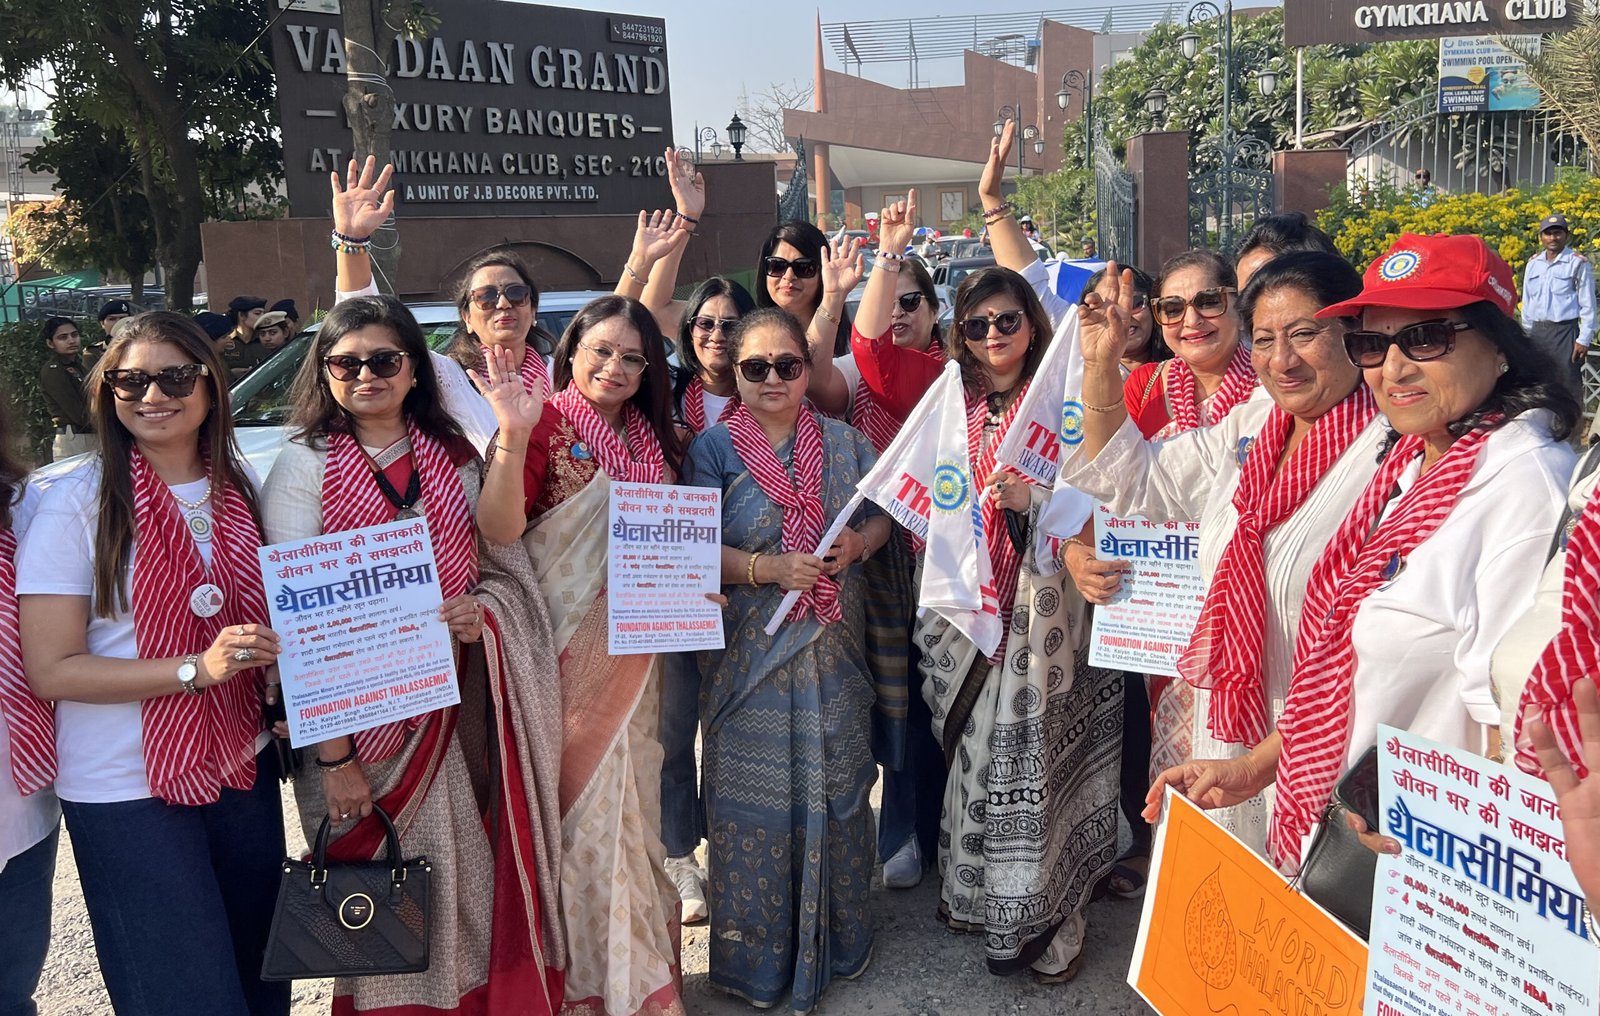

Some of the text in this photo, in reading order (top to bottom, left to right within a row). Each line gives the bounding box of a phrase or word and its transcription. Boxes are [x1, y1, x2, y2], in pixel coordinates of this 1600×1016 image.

[1354, 0, 1567, 28] GYMKHANA CLUB
[287, 25, 666, 94] VADAAN GRAND
[1442, 58, 1477, 67] SWIMMING
[1478, 56, 1494, 65] POOL
[1496, 56, 1512, 64] OPEN
[1442, 95, 1485, 104] SWIMMING
[347, 102, 636, 139] XURY BANQUETS
[311, 148, 342, 172] AT
[388, 149, 495, 174] MKHANA
[502, 152, 567, 180] CLUB,
[574, 154, 613, 176] SEC
[406, 186, 415, 200] A
[418, 186, 449, 200] UNIT
[454, 186, 469, 200] OF
[496, 186, 544, 200] DECORE
[547, 186, 572, 200] PVT.
[574, 186, 599, 200] LTD.
[1026, 420, 1060, 464] Th
[618, 501, 715, 516] जीवन भर की समझदारी
[668, 490, 678, 500] की
[683, 492, 718, 503] जानकारी
[613, 517, 716, 543] थैलासीमिया
[1105, 517, 1135, 528] जीवन
[269, 523, 424, 562] थैलासीमिया की जानकारी
[276, 540, 423, 578] जीवन भर की समझदारी
[277, 564, 431, 612] थैलासीमिया
[616, 620, 716, 632] FOUNDATION AGAINST THALASSAEMIA
[1100, 636, 1141, 649] FOUNDATION
[1143, 641, 1172, 653] AGAINST
[300, 698, 351, 719] FOUNDATION
[354, 688, 387, 706] AGAINST
[390, 673, 448, 696] THALASSAEMIA
[321, 715, 340, 723] Kalyan
[344, 709, 360, 717] Singh
[1387, 738, 1478, 786] थैलासीमिया
[1488, 775, 1511, 800] की
[1393, 769, 1437, 801] जीवन
[1446, 791, 1469, 815] भर
[1478, 802, 1500, 828] की
[1388, 800, 1589, 936] थैलासीमिया
[1405, 854, 1425, 871] जीवन
[1428, 866, 1439, 879] भर
[1441, 872, 1451, 885] हर
[1454, 879, 1472, 896] महीने
[1475, 890, 1489, 907] खून
[1429, 888, 1436, 898] से
[1439, 893, 1469, 916] 2,00,000
[1490, 921, 1514, 942] सालाना
[1254, 898, 1348, 1008] WORLD
[1402, 892, 1409, 904] 4
[1436, 912, 1460, 930] भारतीय
[1518, 957, 1526, 969] से
[1528, 964, 1554, 985] प्रभावित
[1398, 931, 1412, 945] जांच
[1415, 939, 1422, 950] से
[1464, 967, 1476, 981] रोग
[1478, 976, 1488, 988] को
[1490, 983, 1506, 1000] रोका
[1508, 995, 1518, 1007] जा
[1400, 913, 1415, 927] शादी
[1418, 923, 1436, 938] अथवा
[1468, 950, 1476, 961] से
[1478, 956, 1493, 971] पहले
[1495, 966, 1508, 982] खून
[1511, 976, 1521, 988] की
[1555, 1002, 1566, 1016] की
[1372, 982, 1382, 994] that
[1383, 988, 1394, 1002] they
[1394, 996, 1403, 1005] are
[1404, 1001, 1421, 1016] minors
[1374, 970, 1407, 995] Thalassaemia
[1409, 990, 1426, 1007] Minors
[1428, 1003, 1437, 1013] are
[1394, 963, 1414, 982] जिनके
[1435, 990, 1451, 1004] पहले
[1456, 999, 1462, 1012] से
[1425, 967, 1440, 981] ग्रस्त
[1444, 978, 1460, 993] बच्चा
[1464, 990, 1480, 1005] उनके
